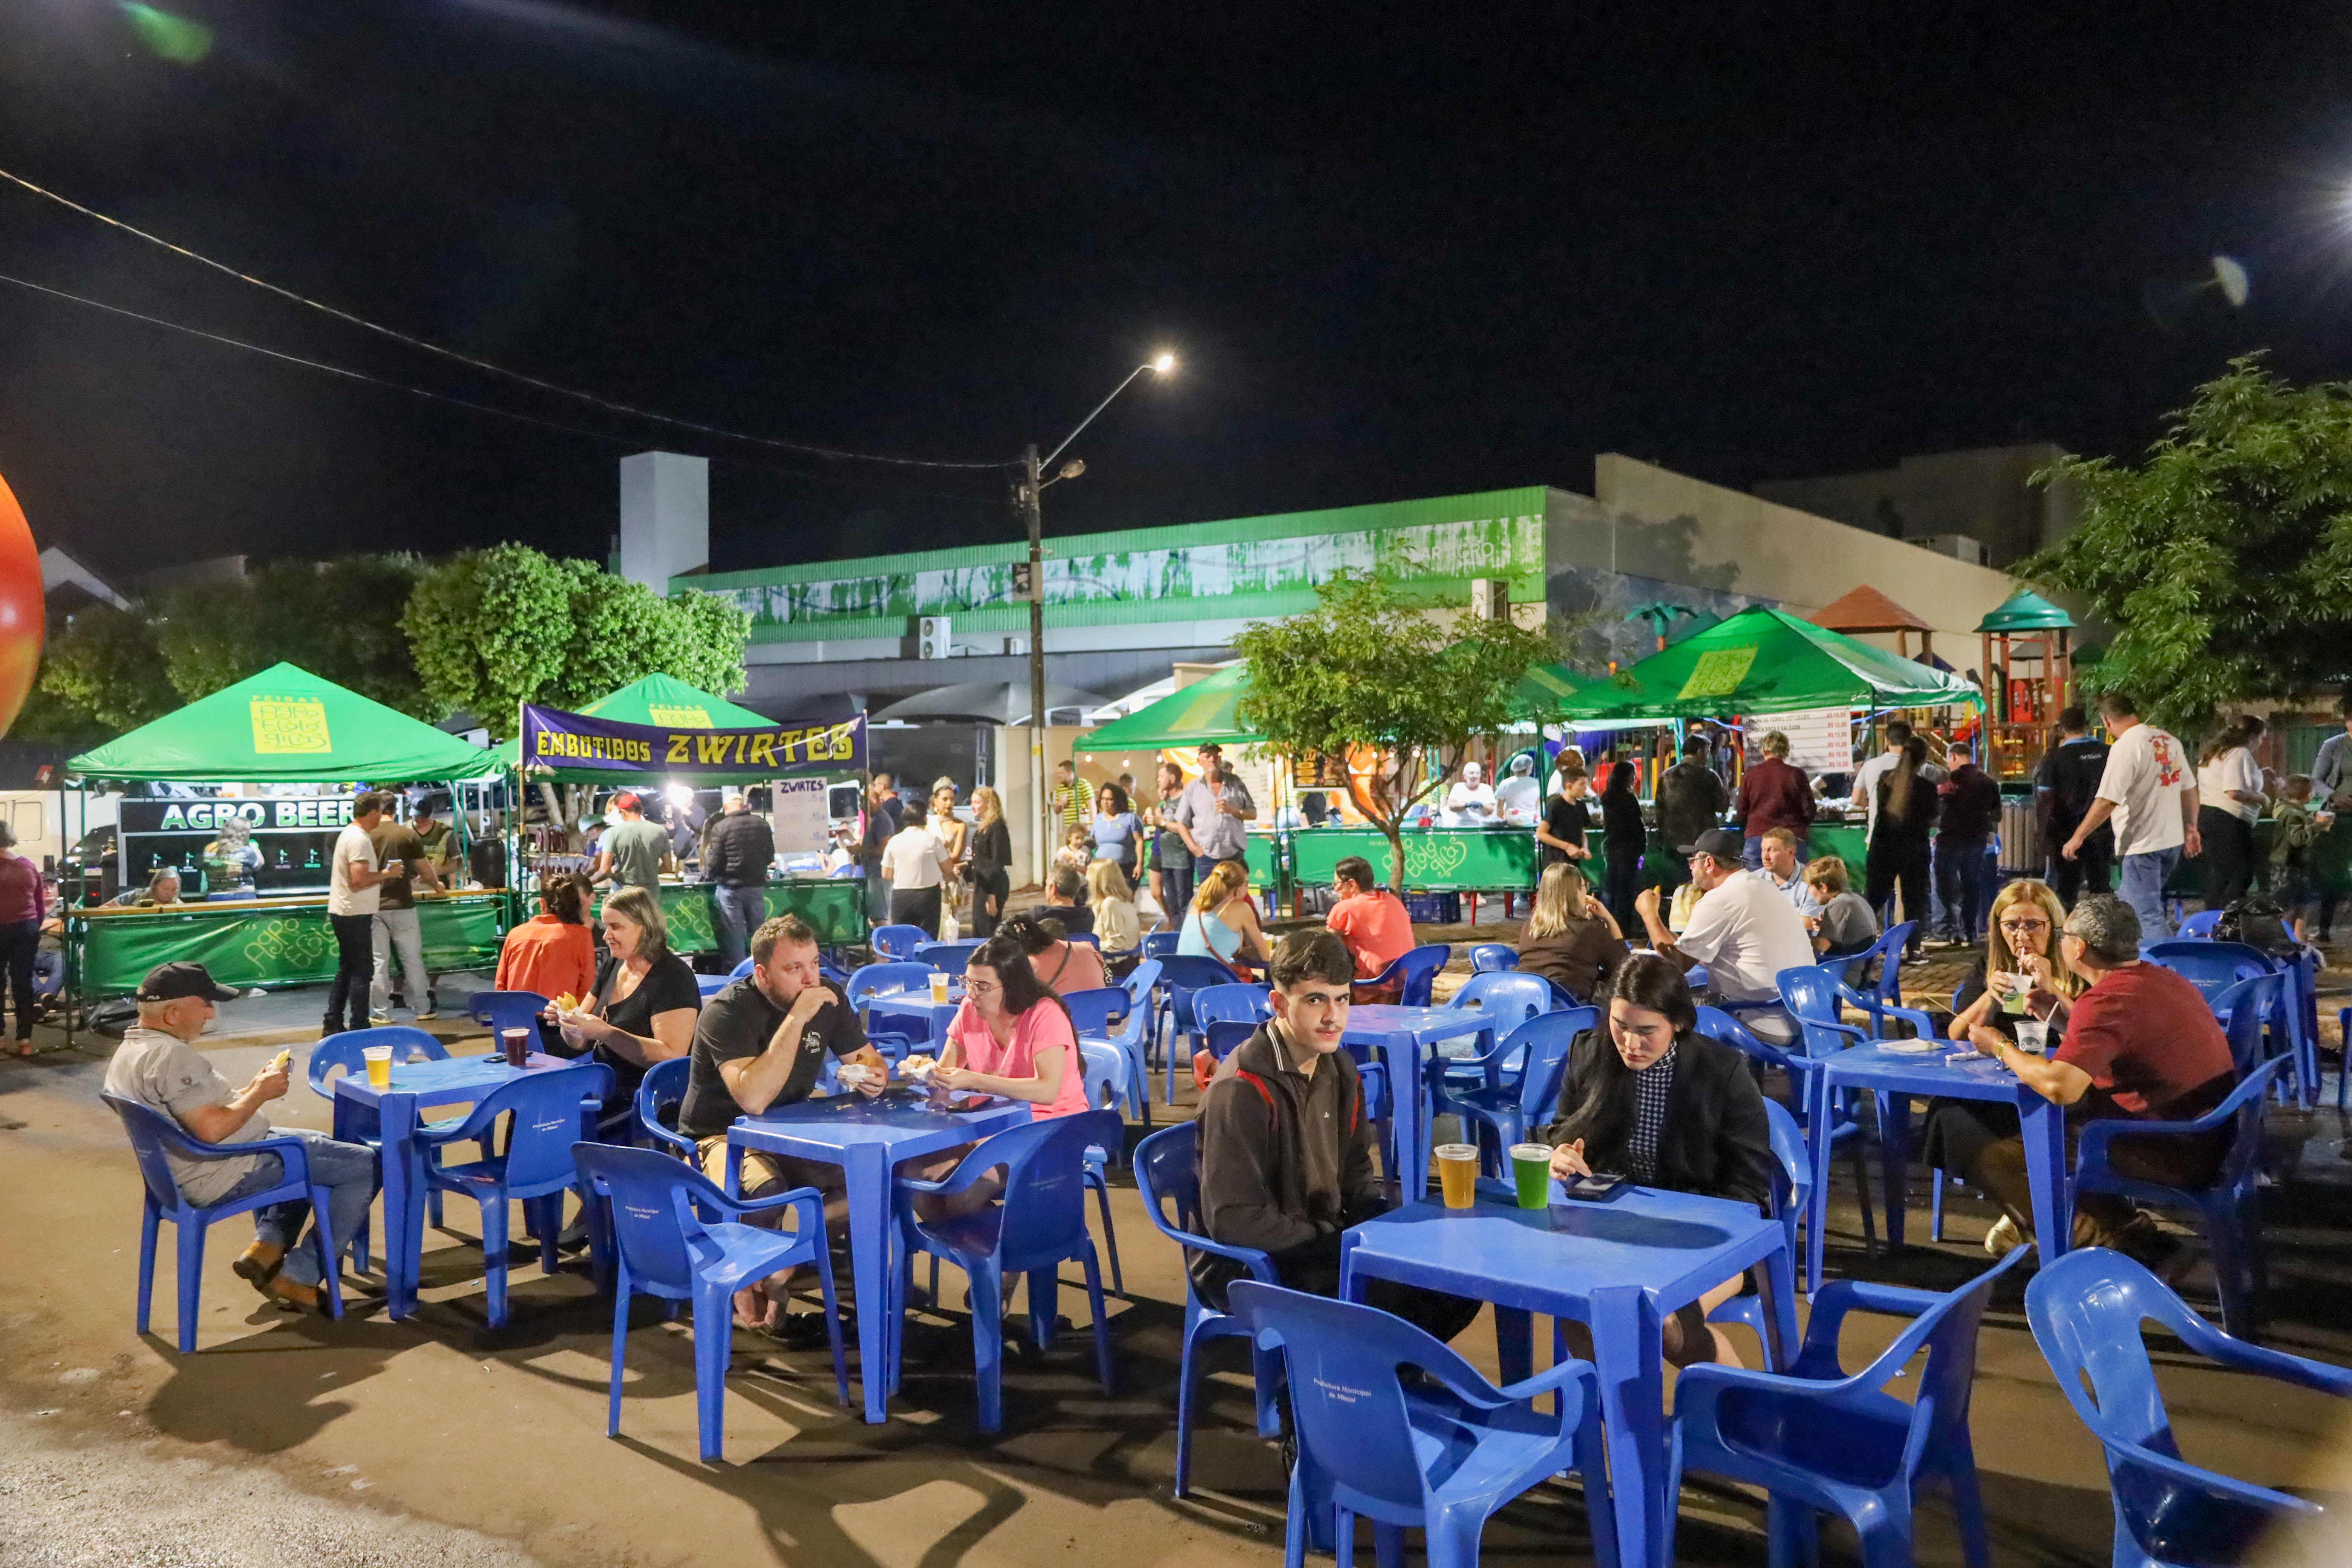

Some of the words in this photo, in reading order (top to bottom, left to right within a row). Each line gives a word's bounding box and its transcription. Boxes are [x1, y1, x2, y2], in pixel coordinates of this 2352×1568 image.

[252, 695, 320, 703] FEIRAS
[537, 730, 651, 762] EMBUTIDOS
[665, 723, 853, 767] ZWIRTES
[780, 780, 824, 793] ZWIRTES
[161, 802, 265, 829] AGRO
[276, 801, 355, 827] BEER
[1314, 1377, 1341, 1391] Prefeitura
[1341, 1386, 1372, 1397] Municipal
